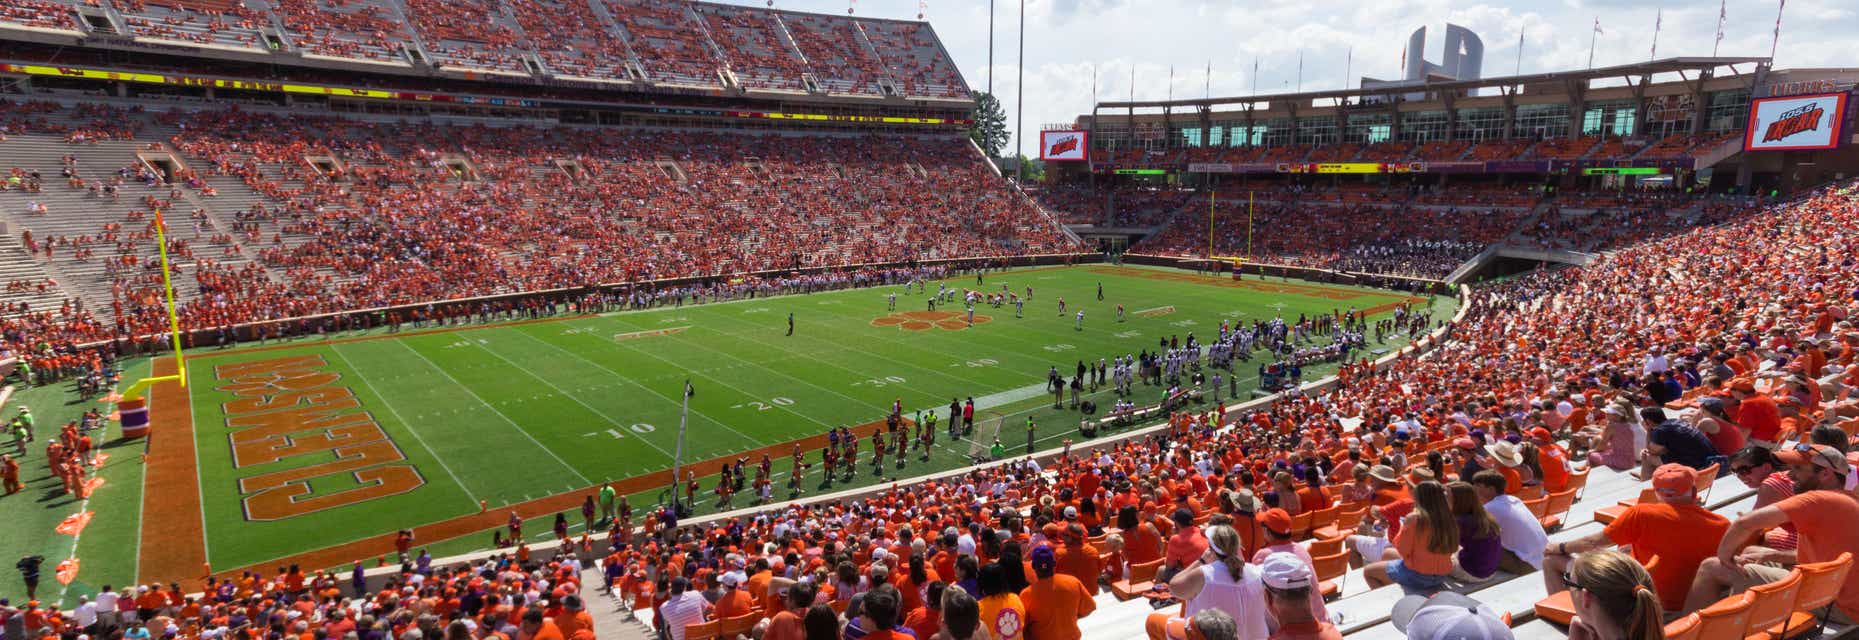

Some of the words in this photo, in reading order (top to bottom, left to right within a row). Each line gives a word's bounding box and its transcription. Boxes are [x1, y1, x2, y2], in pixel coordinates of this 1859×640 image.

[866, 375, 906, 388] 30
[747, 396, 795, 412] 20
[606, 423, 656, 440] 10
